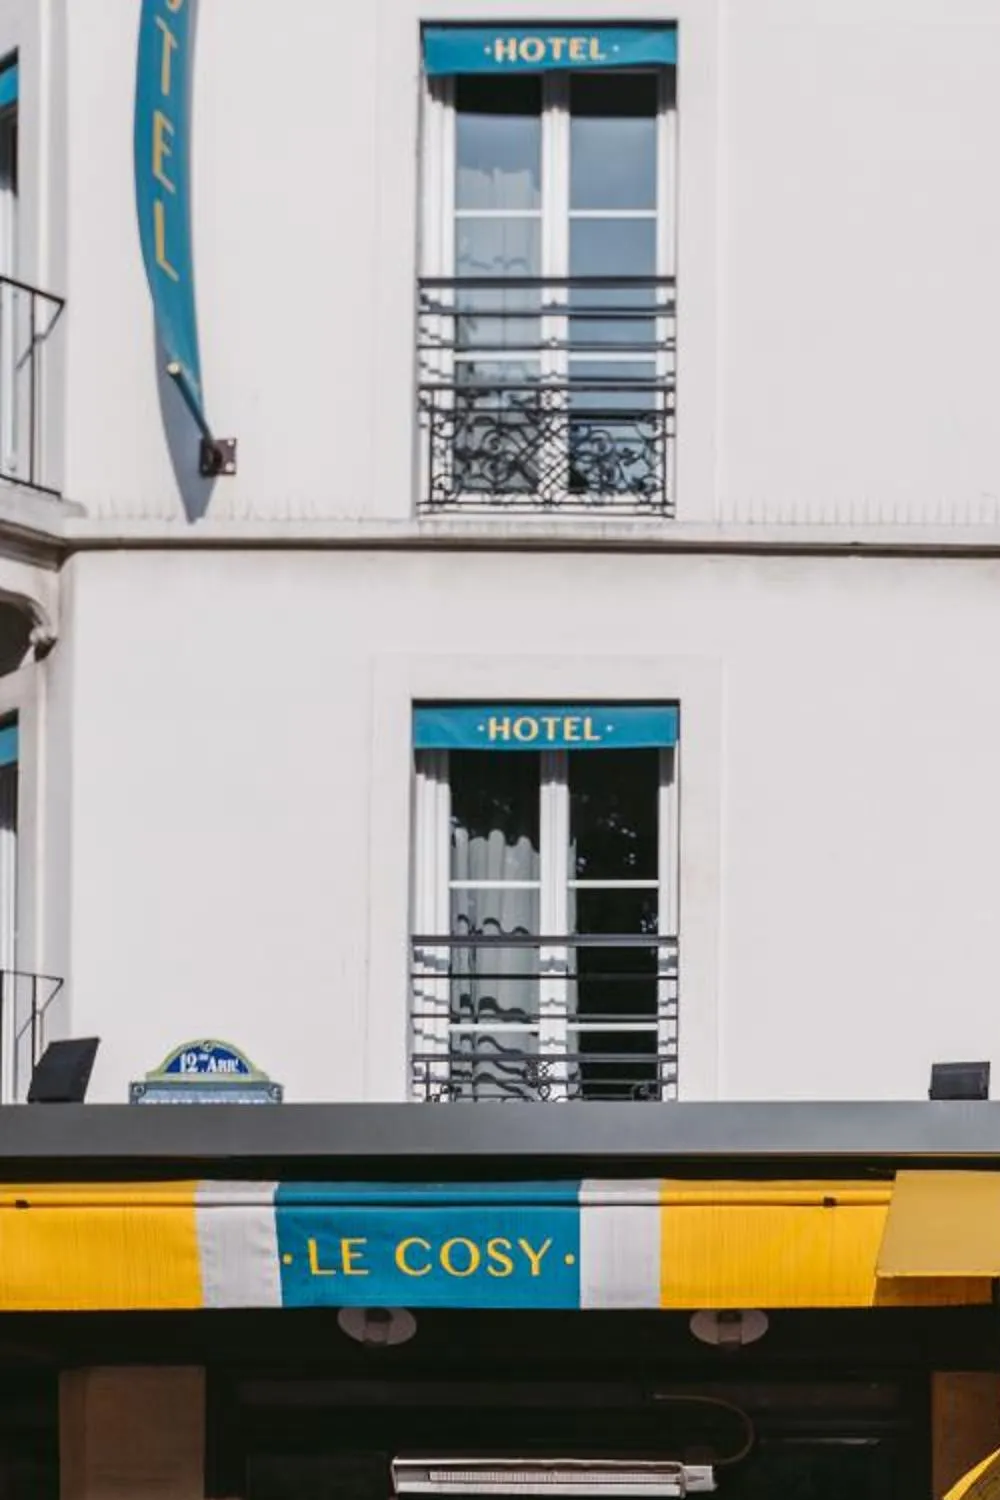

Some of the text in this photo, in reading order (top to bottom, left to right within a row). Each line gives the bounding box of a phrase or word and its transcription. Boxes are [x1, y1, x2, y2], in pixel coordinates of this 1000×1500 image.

[494, 36, 607, 63] HOTEL
[154, 0, 180, 282] TEL
[488, 716, 602, 742] HOTEL
[307, 1236, 553, 1278] LE COSY
